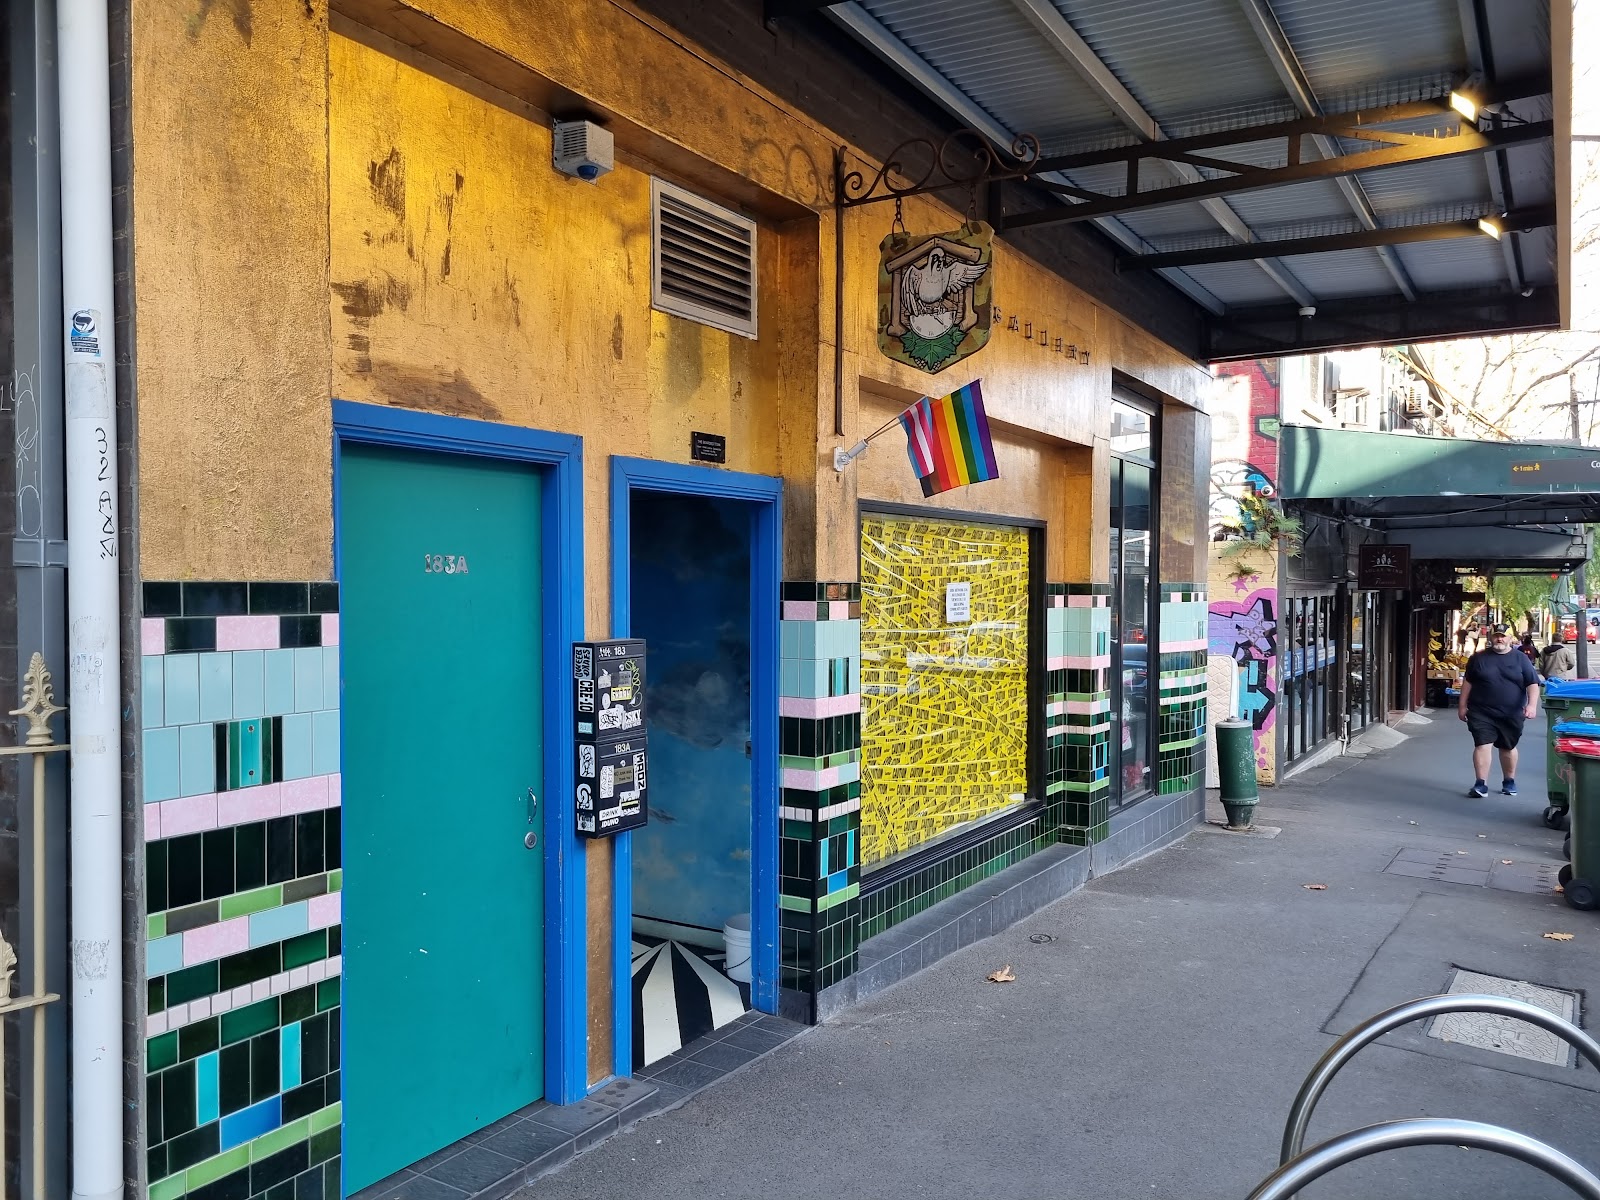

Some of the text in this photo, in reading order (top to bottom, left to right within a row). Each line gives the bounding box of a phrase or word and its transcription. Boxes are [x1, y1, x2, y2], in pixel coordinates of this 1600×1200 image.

[425, 554, 469, 574] 183A
[614, 646, 626, 656] 183
[615, 743, 631, 753] 183A
